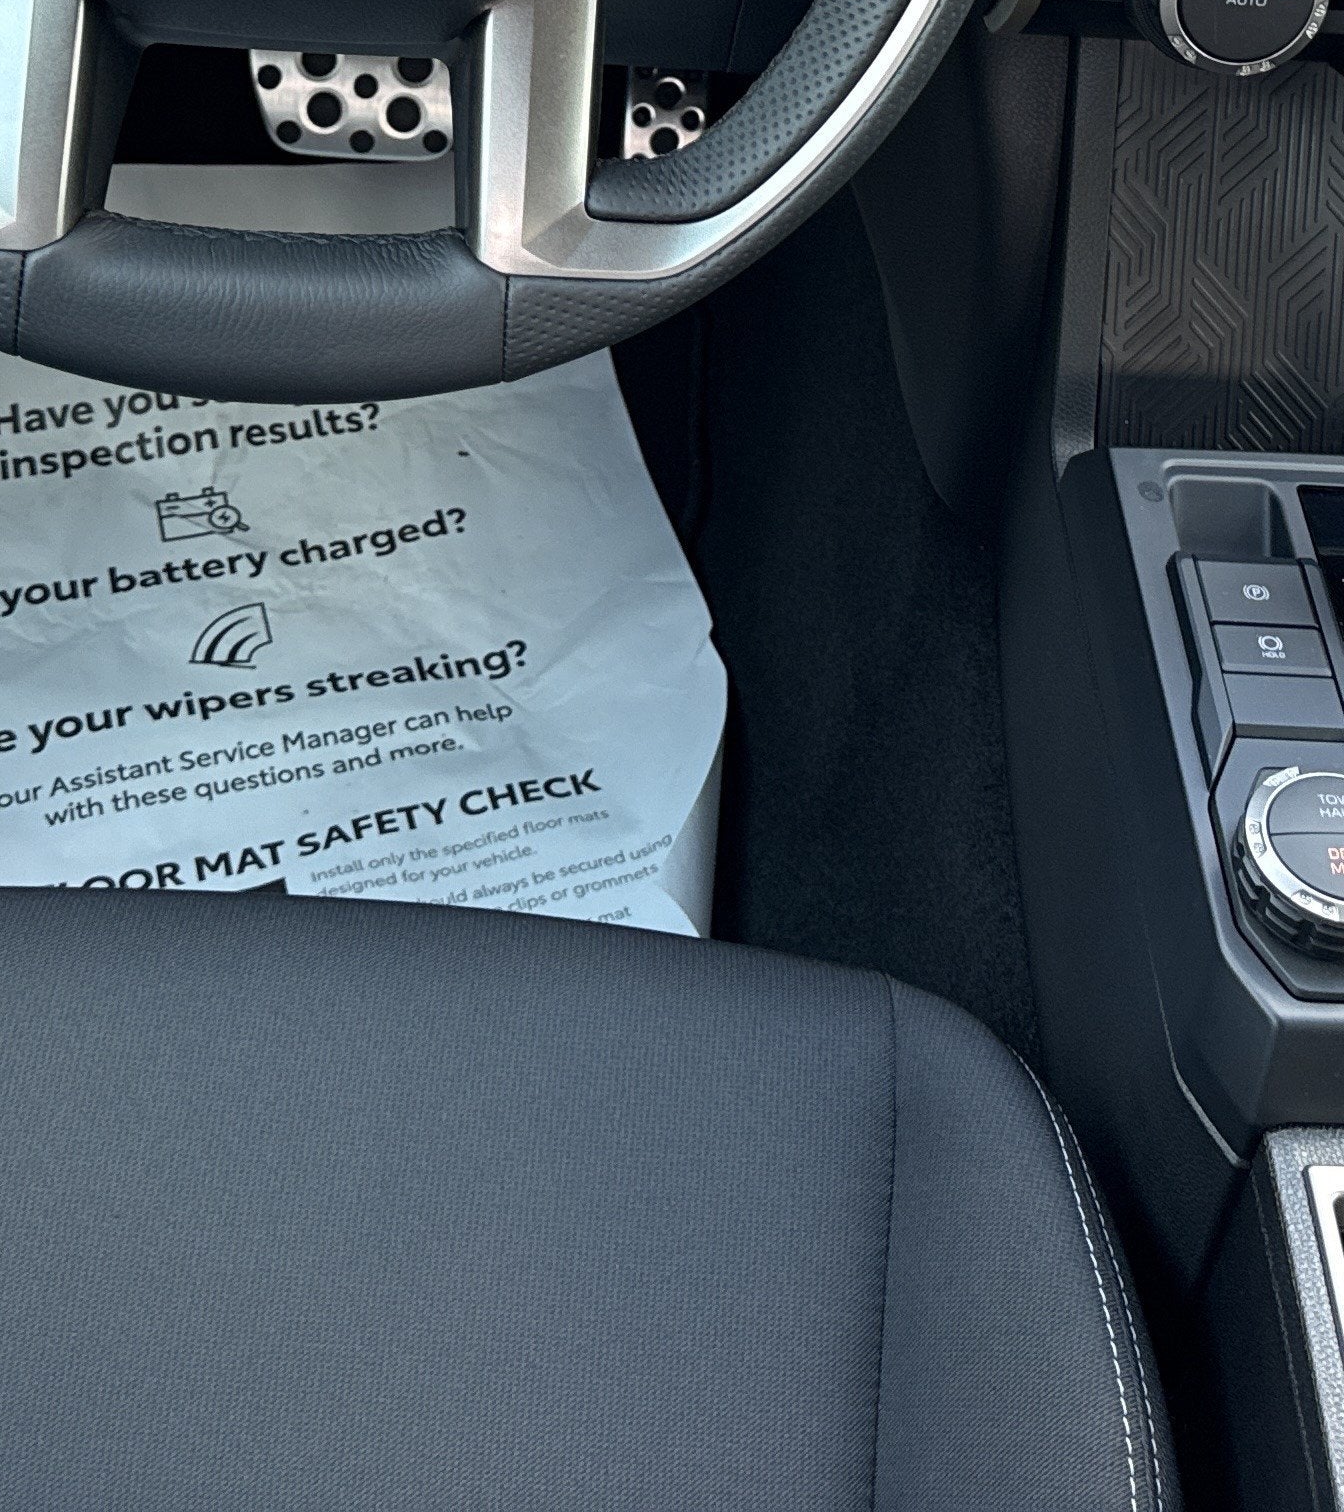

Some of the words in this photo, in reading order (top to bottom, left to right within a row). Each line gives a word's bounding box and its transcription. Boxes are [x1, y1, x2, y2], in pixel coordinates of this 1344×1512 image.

[103, 391, 180, 429] you
[230, 403, 381, 449] results?
[0, 575, 98, 617] your
[109, 550, 268, 595] battery
[280, 507, 468, 569] charged?
[1262, 651, 1286, 659] HOLD
[29, 701, 132, 753] your
[143, 682, 295, 721] wipers
[307, 639, 528, 698] streaking?
[45, 799, 105, 828] with
[112, 784, 188, 813] these
[194, 759, 325, 802] questions
[332, 748, 382, 774] and
[389, 737, 464, 763] more.
[49, 754, 173, 798] Assistant
[179, 735, 288, 771] Service
[283, 718, 397, 758] Manager
[405, 708, 450, 731] can
[455, 700, 514, 724] help
[194, 840, 285, 882] MAT
[297, 798, 448, 858] SAFETY
[459, 768, 603, 818] CHECK
[310, 859, 364, 883] Install
[368, 851, 406, 871] only
[409, 847, 438, 861] the
[441, 826, 519, 857] specified
[523, 816, 564, 835] floor
[567, 807, 610, 824] mats
[401, 868, 426, 884] for
[430, 861, 469, 883] your
[472, 845, 538, 870] vehicle.
[473, 876, 530, 901] always
[532, 869, 556, 885] be
[559, 852, 627, 877] secured
[630, 834, 673, 862] using
[550, 888, 568, 901] or
[572, 863, 659, 899] grommets
